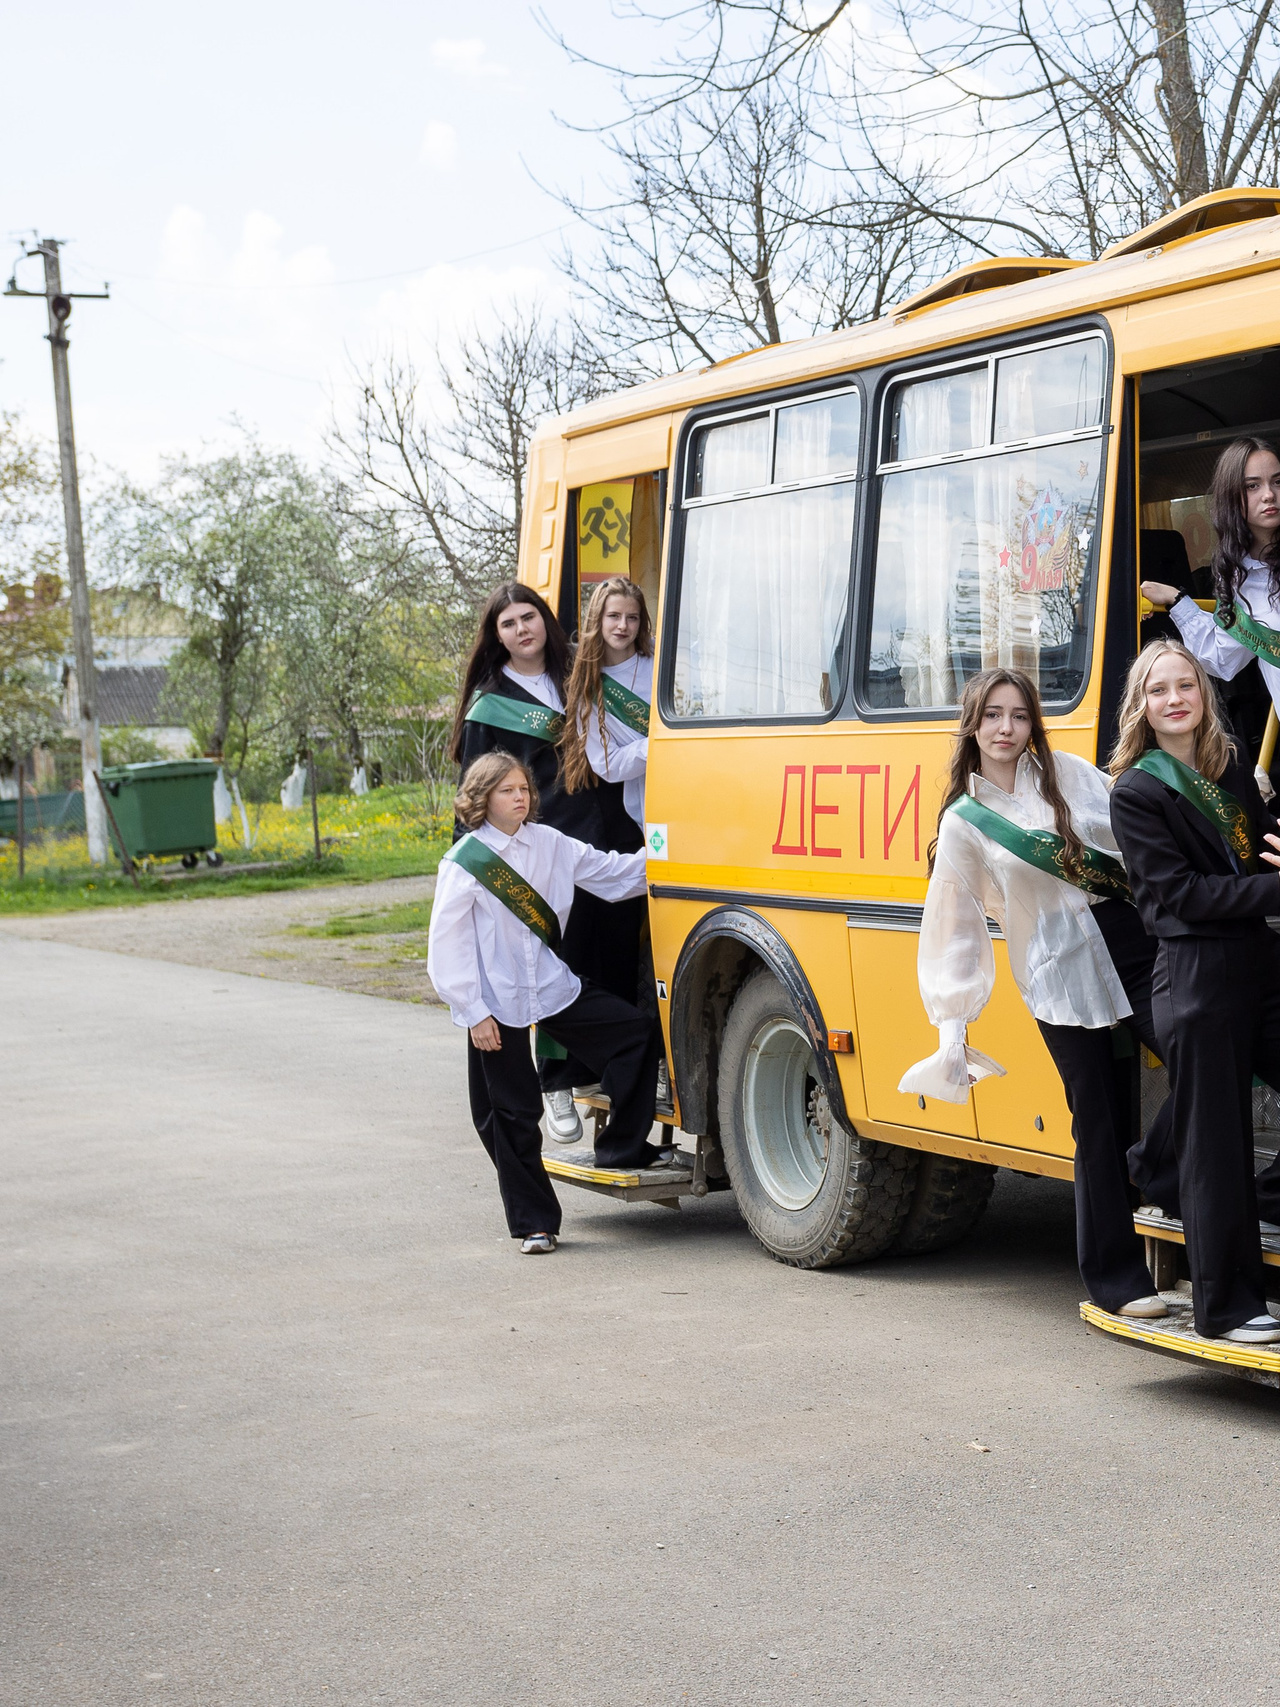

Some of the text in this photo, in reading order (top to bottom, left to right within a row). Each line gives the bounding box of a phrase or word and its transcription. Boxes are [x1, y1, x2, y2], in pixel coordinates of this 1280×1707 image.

[1021, 544, 1062, 591] 9 МАЯ
[772, 765, 921, 861] ДЕТИ
